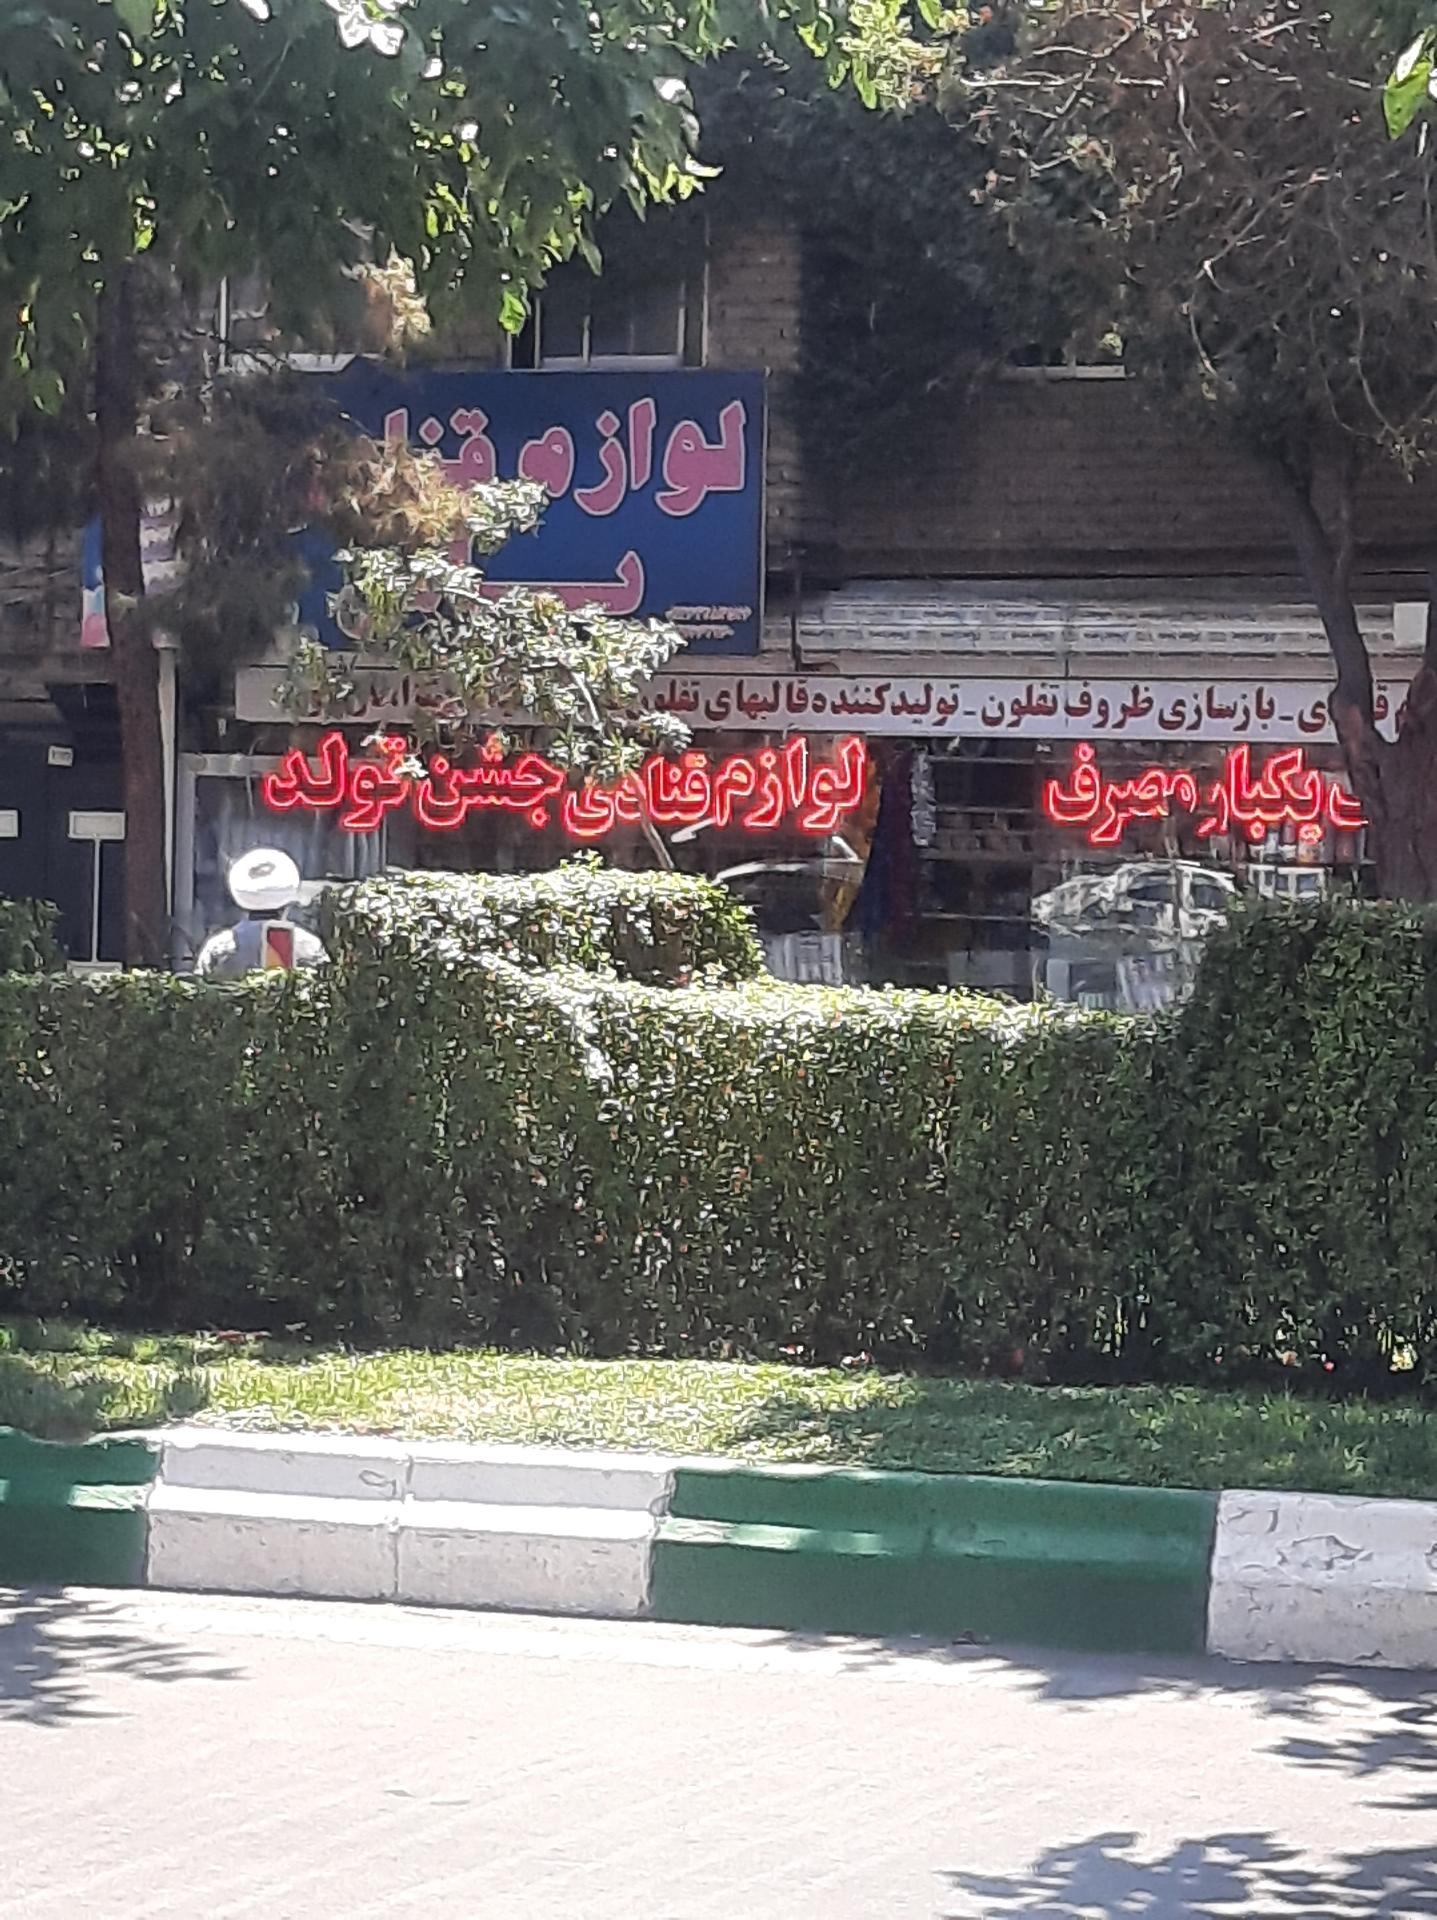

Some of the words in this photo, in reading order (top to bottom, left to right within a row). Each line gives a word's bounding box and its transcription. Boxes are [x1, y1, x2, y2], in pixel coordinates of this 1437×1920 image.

[518, 396, 747, 517] لوازم
[704, 678, 809, 722] قالبهای
[981, 682, 1059, 733] تفلون
[1064, 681, 1155, 729] ظروف
[1158, 685, 1276, 732] بازسازی
[263, 730, 412, 832] تولد
[415, 732, 567, 831] جشن
[562, 749, 713, 840] قنادی
[713, 734, 868, 834] لوازم
[1044, 741, 1199, 847] مصرف
[1197, 742, 1325, 846] یکبار
